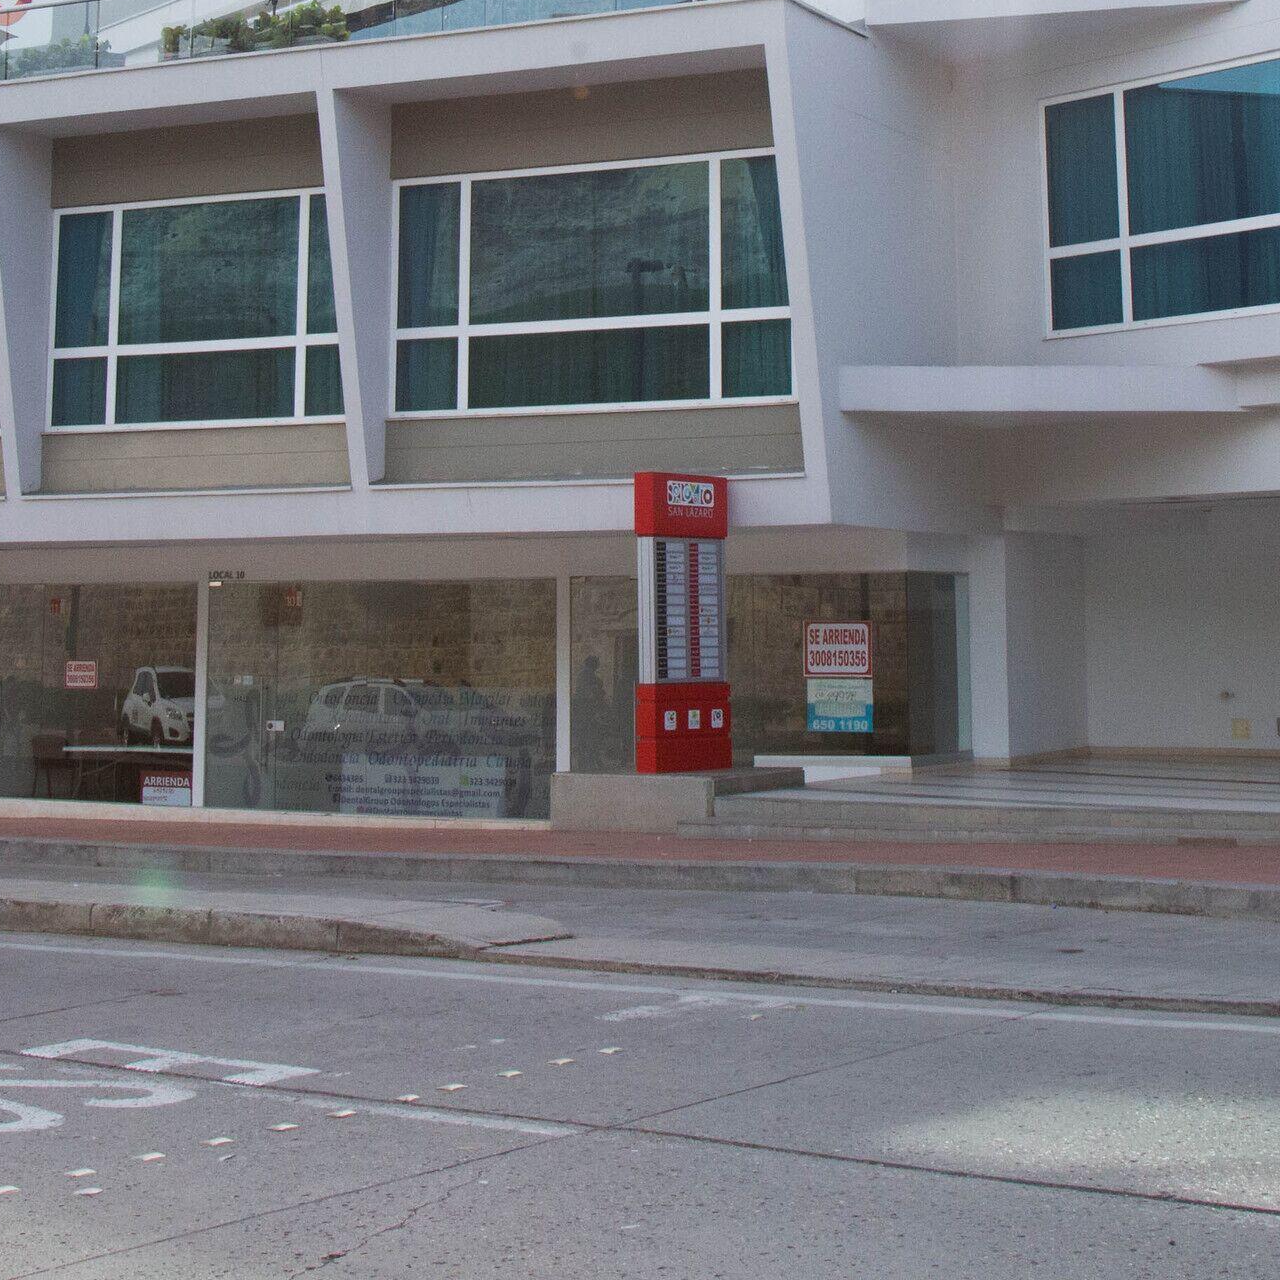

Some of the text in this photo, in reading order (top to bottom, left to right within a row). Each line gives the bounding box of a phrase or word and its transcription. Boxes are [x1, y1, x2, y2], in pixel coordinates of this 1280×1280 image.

[209, 570, 245, 579] LOCAL 10
[810, 629, 866, 645] SE ARRIENDA
[809, 650, 866, 667] 3008150356
[143, 776, 190, 787] ARRIENDA
